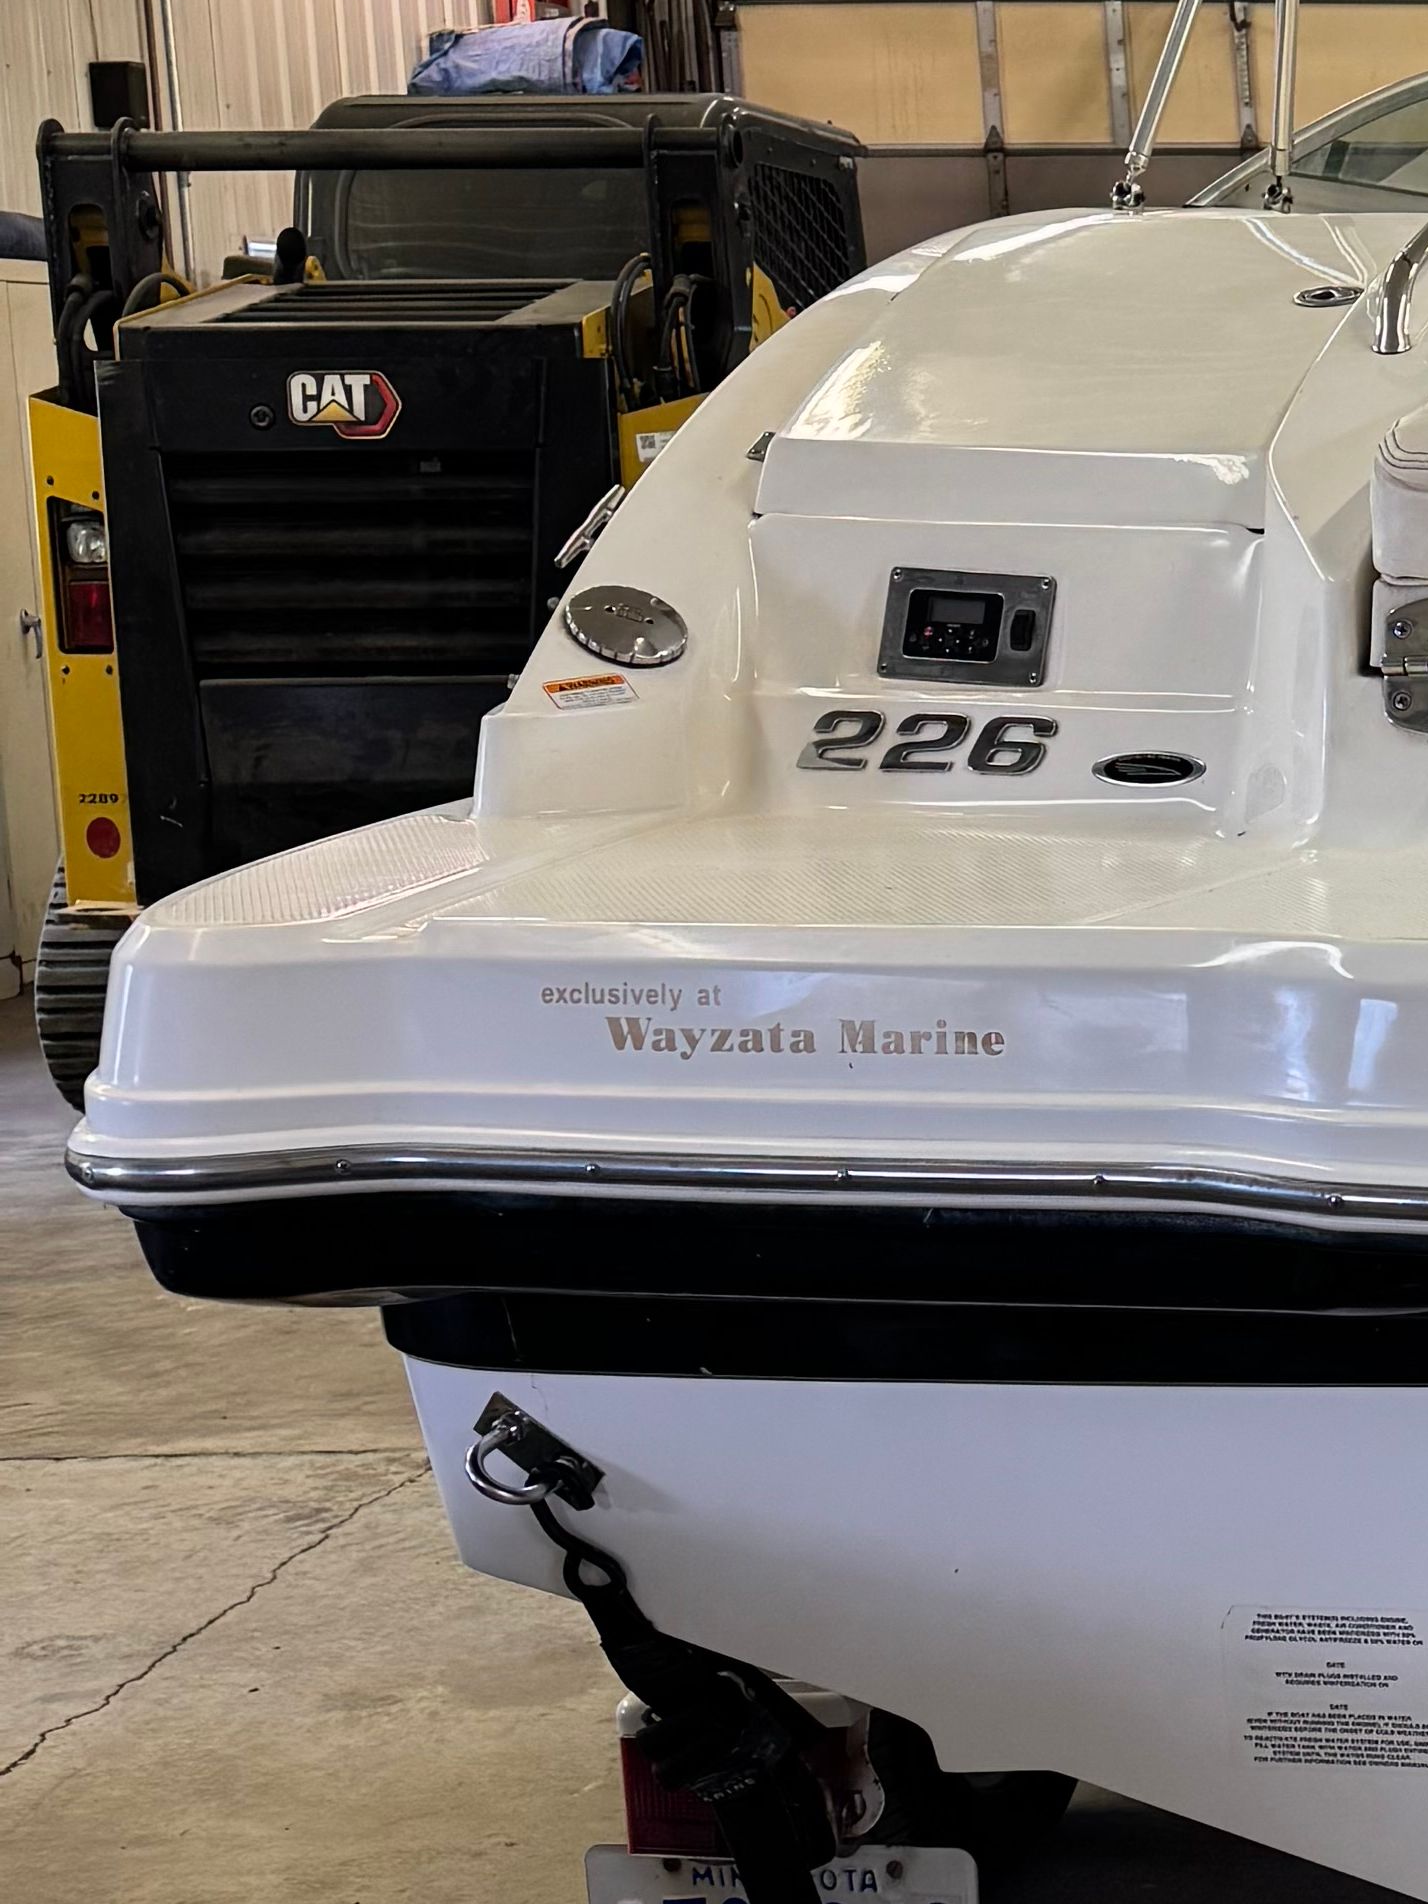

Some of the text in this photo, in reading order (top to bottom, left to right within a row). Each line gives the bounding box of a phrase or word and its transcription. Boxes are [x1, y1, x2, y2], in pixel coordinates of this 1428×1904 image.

[291, 374, 370, 421] CAT
[796, 709, 1058, 775] 226
[541, 982, 722, 1014] exclusively at
[605, 1016, 1006, 1061] Wayzata Marine
